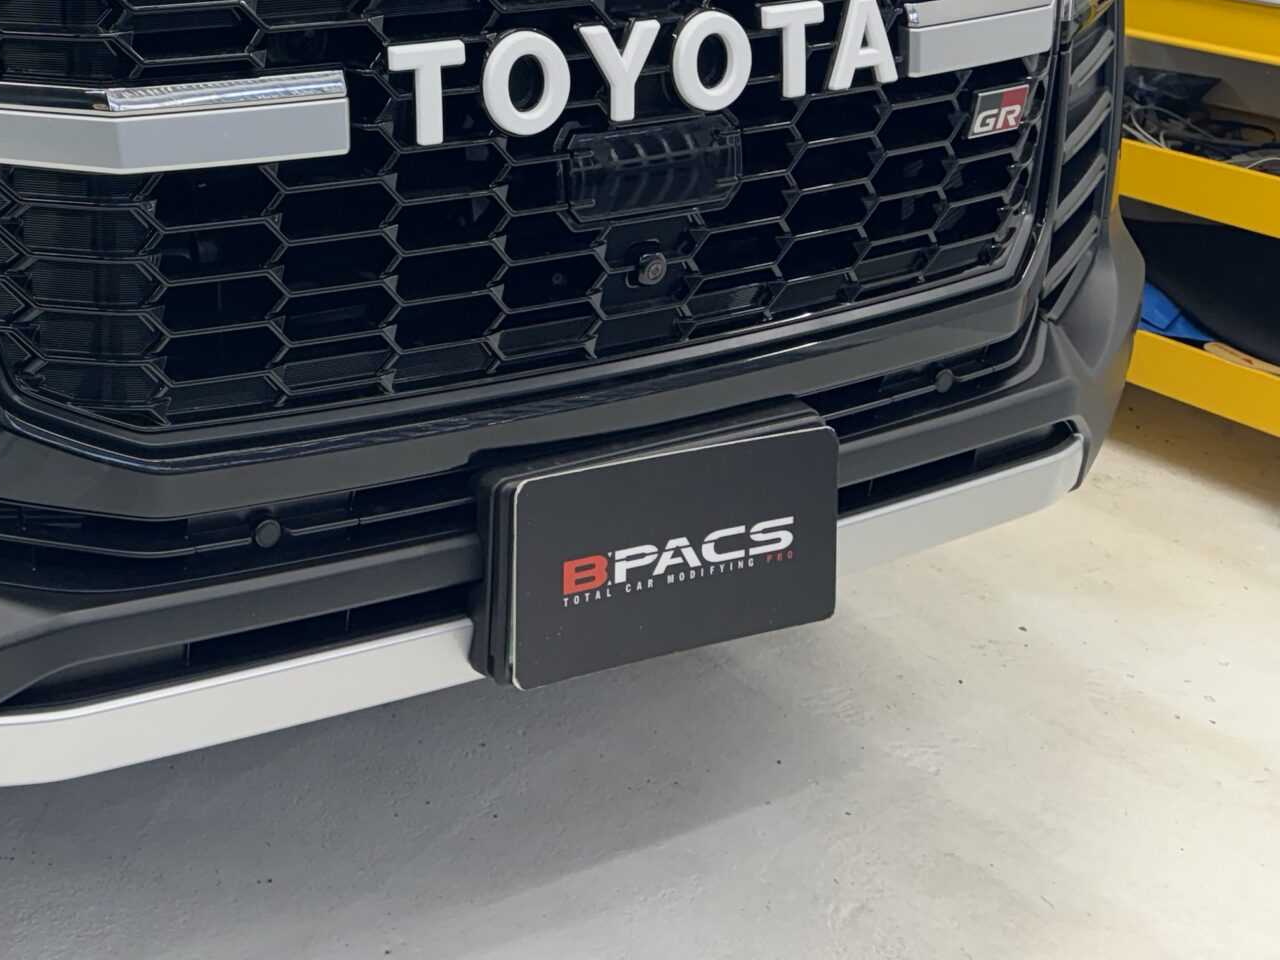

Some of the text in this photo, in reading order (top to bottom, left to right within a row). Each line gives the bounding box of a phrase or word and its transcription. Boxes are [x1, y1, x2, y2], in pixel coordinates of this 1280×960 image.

[973, 104, 1022, 134] GR
[562, 550, 795, 608] TOTAL CAR MODIFYING PRO
